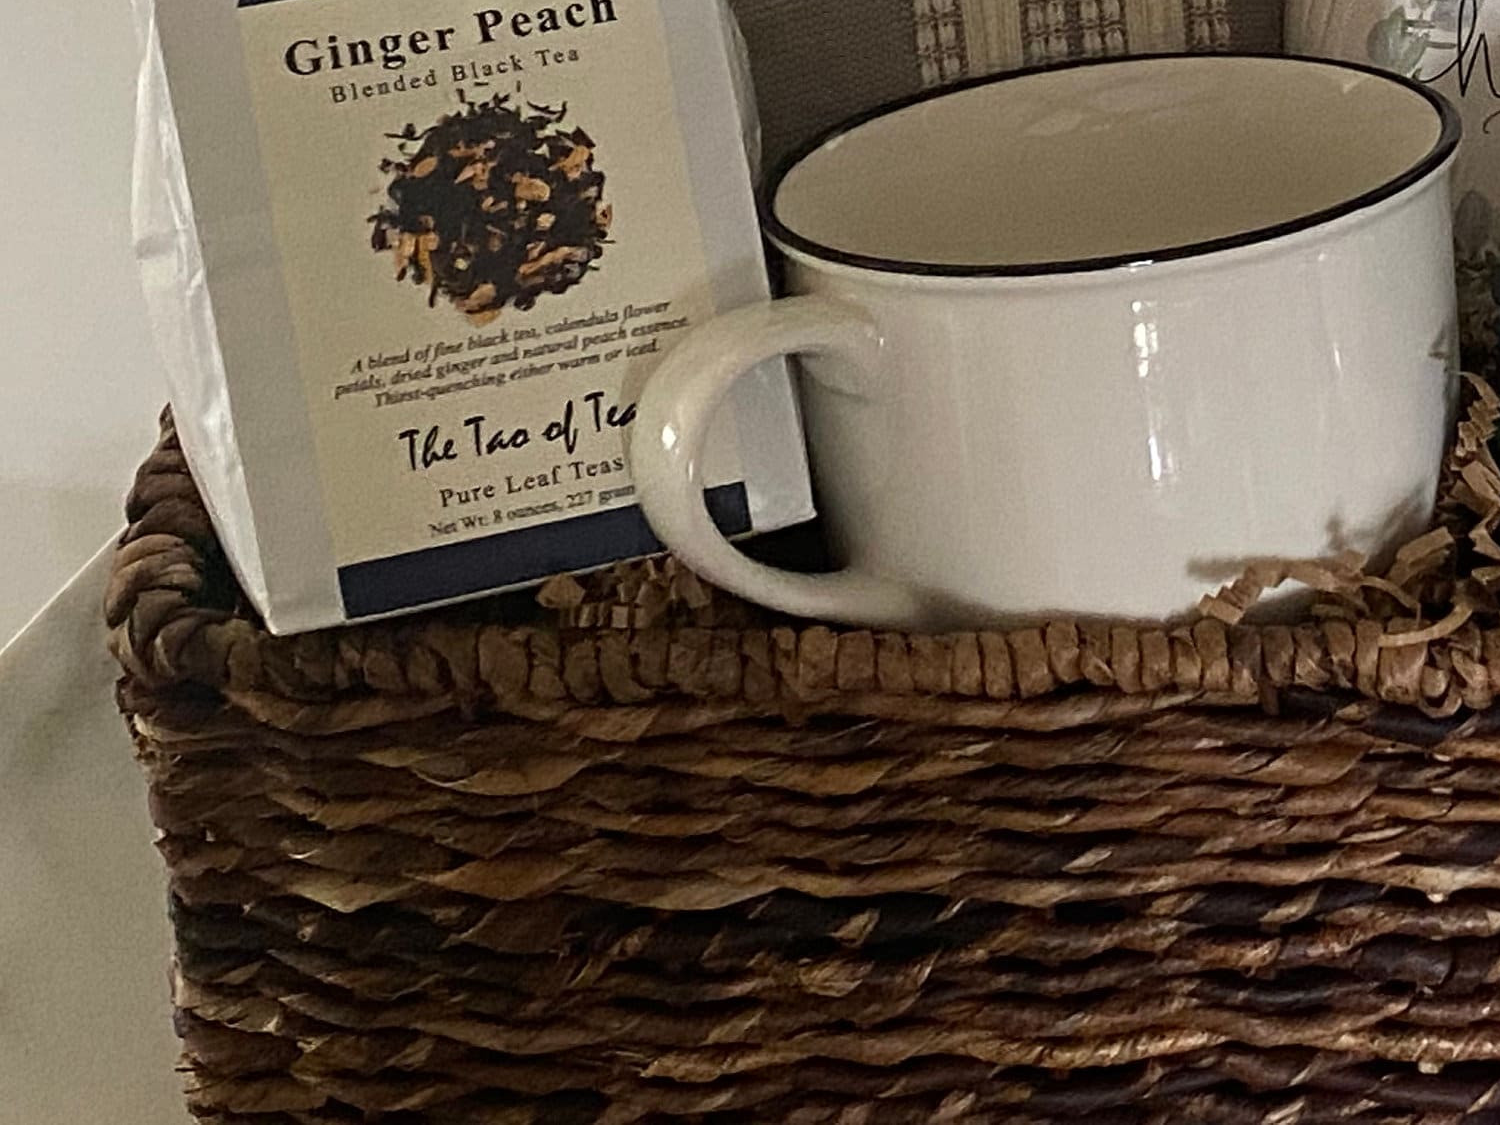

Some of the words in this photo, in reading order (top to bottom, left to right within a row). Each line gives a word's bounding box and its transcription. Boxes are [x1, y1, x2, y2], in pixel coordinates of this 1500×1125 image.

[284, 27, 455, 76] Ginger
[330, 70, 438, 104] Blended
[451, 55, 524, 82] Black
[535, 48, 580, 67] Tea
[351, 359, 363, 373] A
[368, 351, 410, 370] blend
[414, 345, 434, 363] of
[432, 341, 464, 362] fine
[467, 333, 508, 352] black
[622, 300, 671, 323] flower
[390, 366, 432, 386] dried
[435, 357, 486, 381] ginger
[489, 349, 518, 366] and
[522, 336, 578, 359] natural
[581, 326, 627, 350] peach
[510, 362, 554, 382] either
[557, 353, 600, 372] warm
[603, 348, 623, 363] or
[398, 425, 457, 471] The
[464, 416, 530, 456] Tao
[541, 399, 579, 455] of
[584, 391, 638, 433] Tea
[439, 481, 495, 508] Pure
[505, 465, 562, 494] Leaf
[568, 456, 625, 480] Teas
[428, 519, 457, 537] Net
[492, 509, 502, 522] 8
[566, 490, 593, 508] 227
